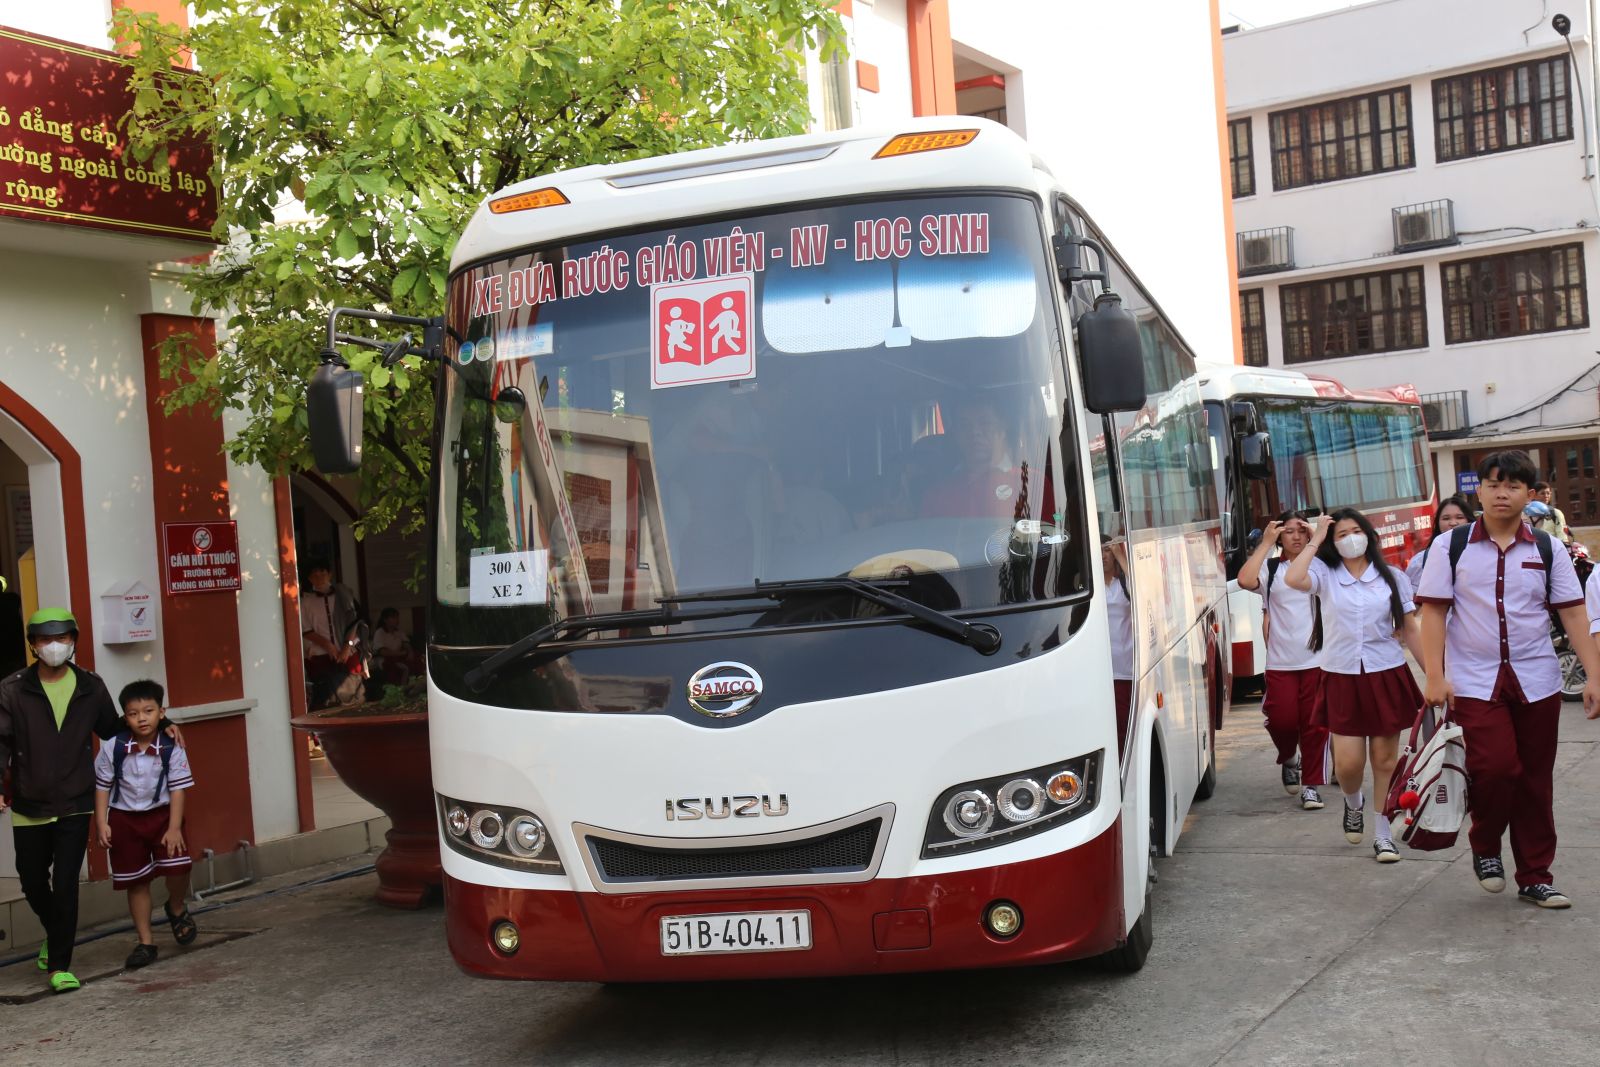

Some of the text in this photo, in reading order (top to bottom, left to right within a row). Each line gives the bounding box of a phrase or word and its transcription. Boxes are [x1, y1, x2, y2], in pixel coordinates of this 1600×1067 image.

[19, 107, 74, 143] đẳng
[80, 122, 118, 150] cấp
[59, 158, 118, 179] ngoài
[124, 165, 172, 192] công
[177, 171, 207, 197] lập
[5, 178, 64, 208] rộng.
[474, 274, 503, 318] XE
[508, 261, 556, 310] ĐƯA
[562, 245, 629, 299] RƯỚC
[636, 235, 697, 287] GIÁO
[703, 226, 764, 278] VIÊN
[791, 224, 829, 268] NV
[920, 213, 989, 256] SINH
[170, 552, 190, 567] CẤM
[209, 550, 236, 565] THUỐC
[489, 560, 526, 576] 300 A
[492, 584, 523, 598] XE 2
[692, 680, 756, 697] SAMCO
[665, 793, 789, 821] ISUZU
[666, 916, 801, 950] 51B-404.11
